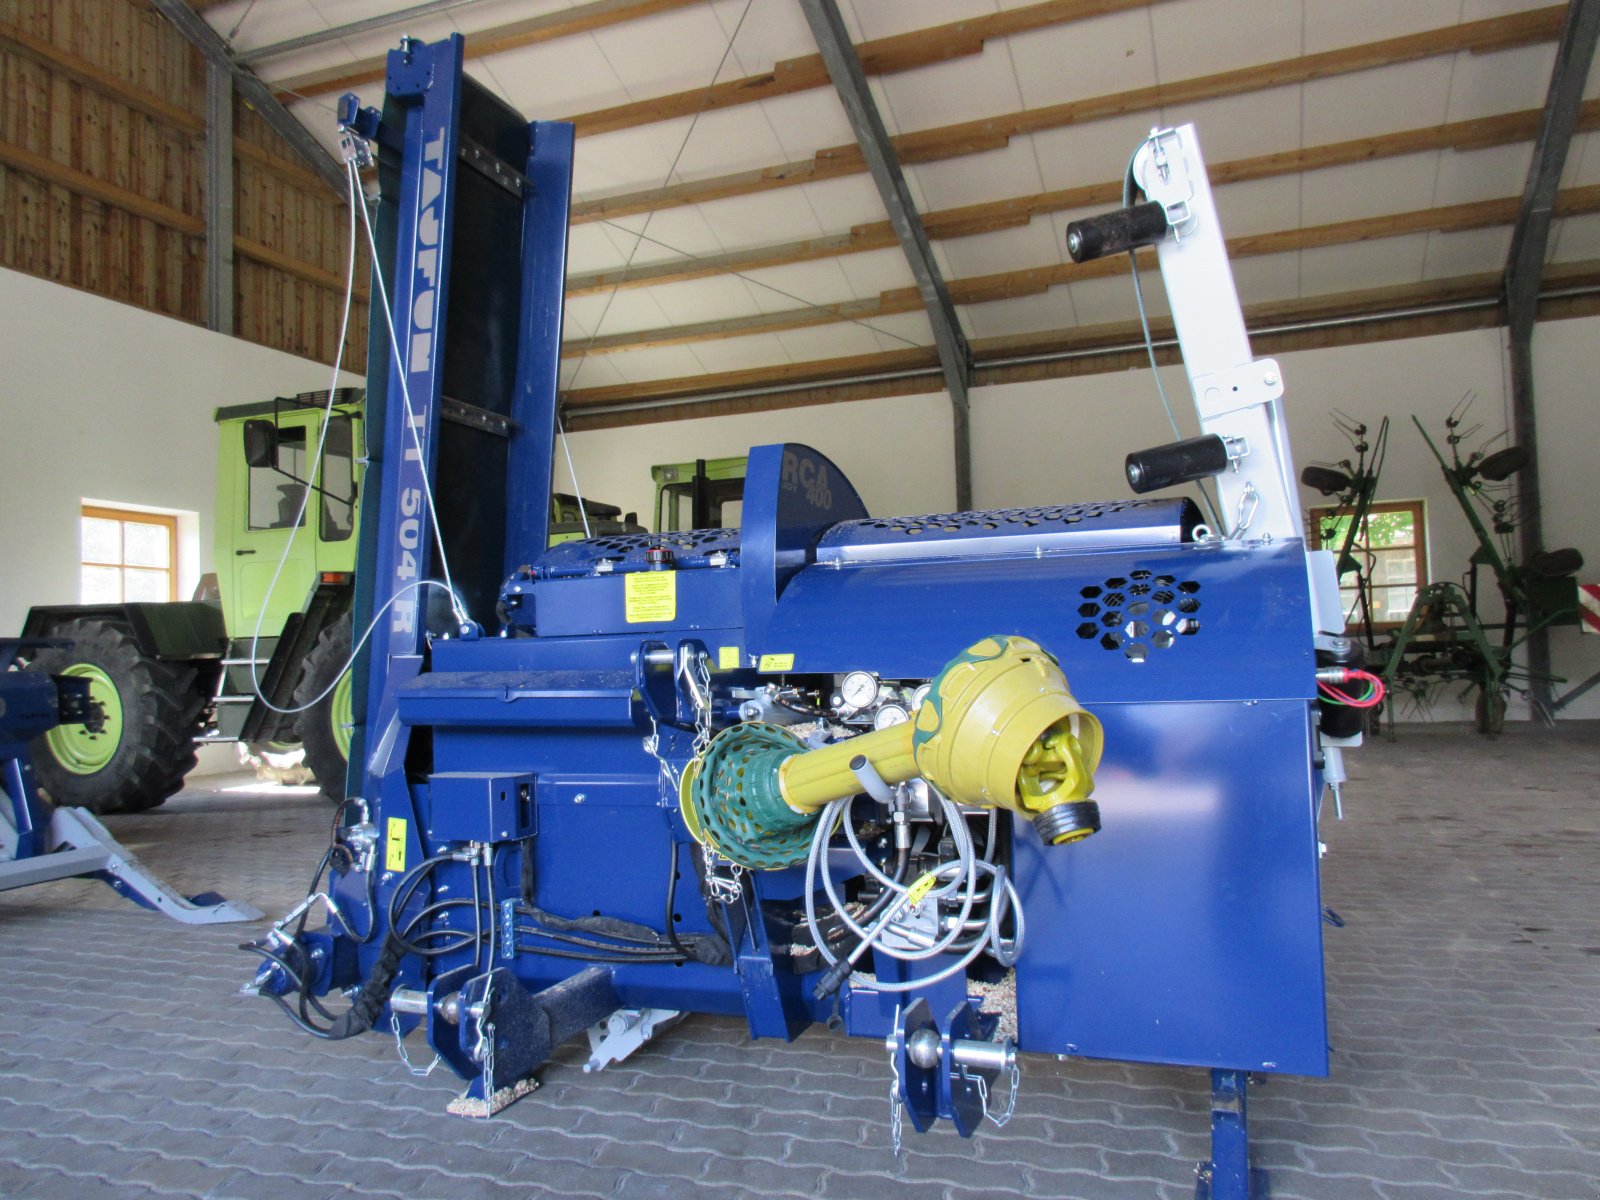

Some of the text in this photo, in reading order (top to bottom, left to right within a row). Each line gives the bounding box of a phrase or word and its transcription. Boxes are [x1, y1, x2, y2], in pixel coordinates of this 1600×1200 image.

[411, 127, 445, 374] TAJFUN
[782, 450, 828, 490] RCA
[806, 485, 832, 510] 400
[397, 487, 421, 580] 504
[392, 600, 412, 634] R
